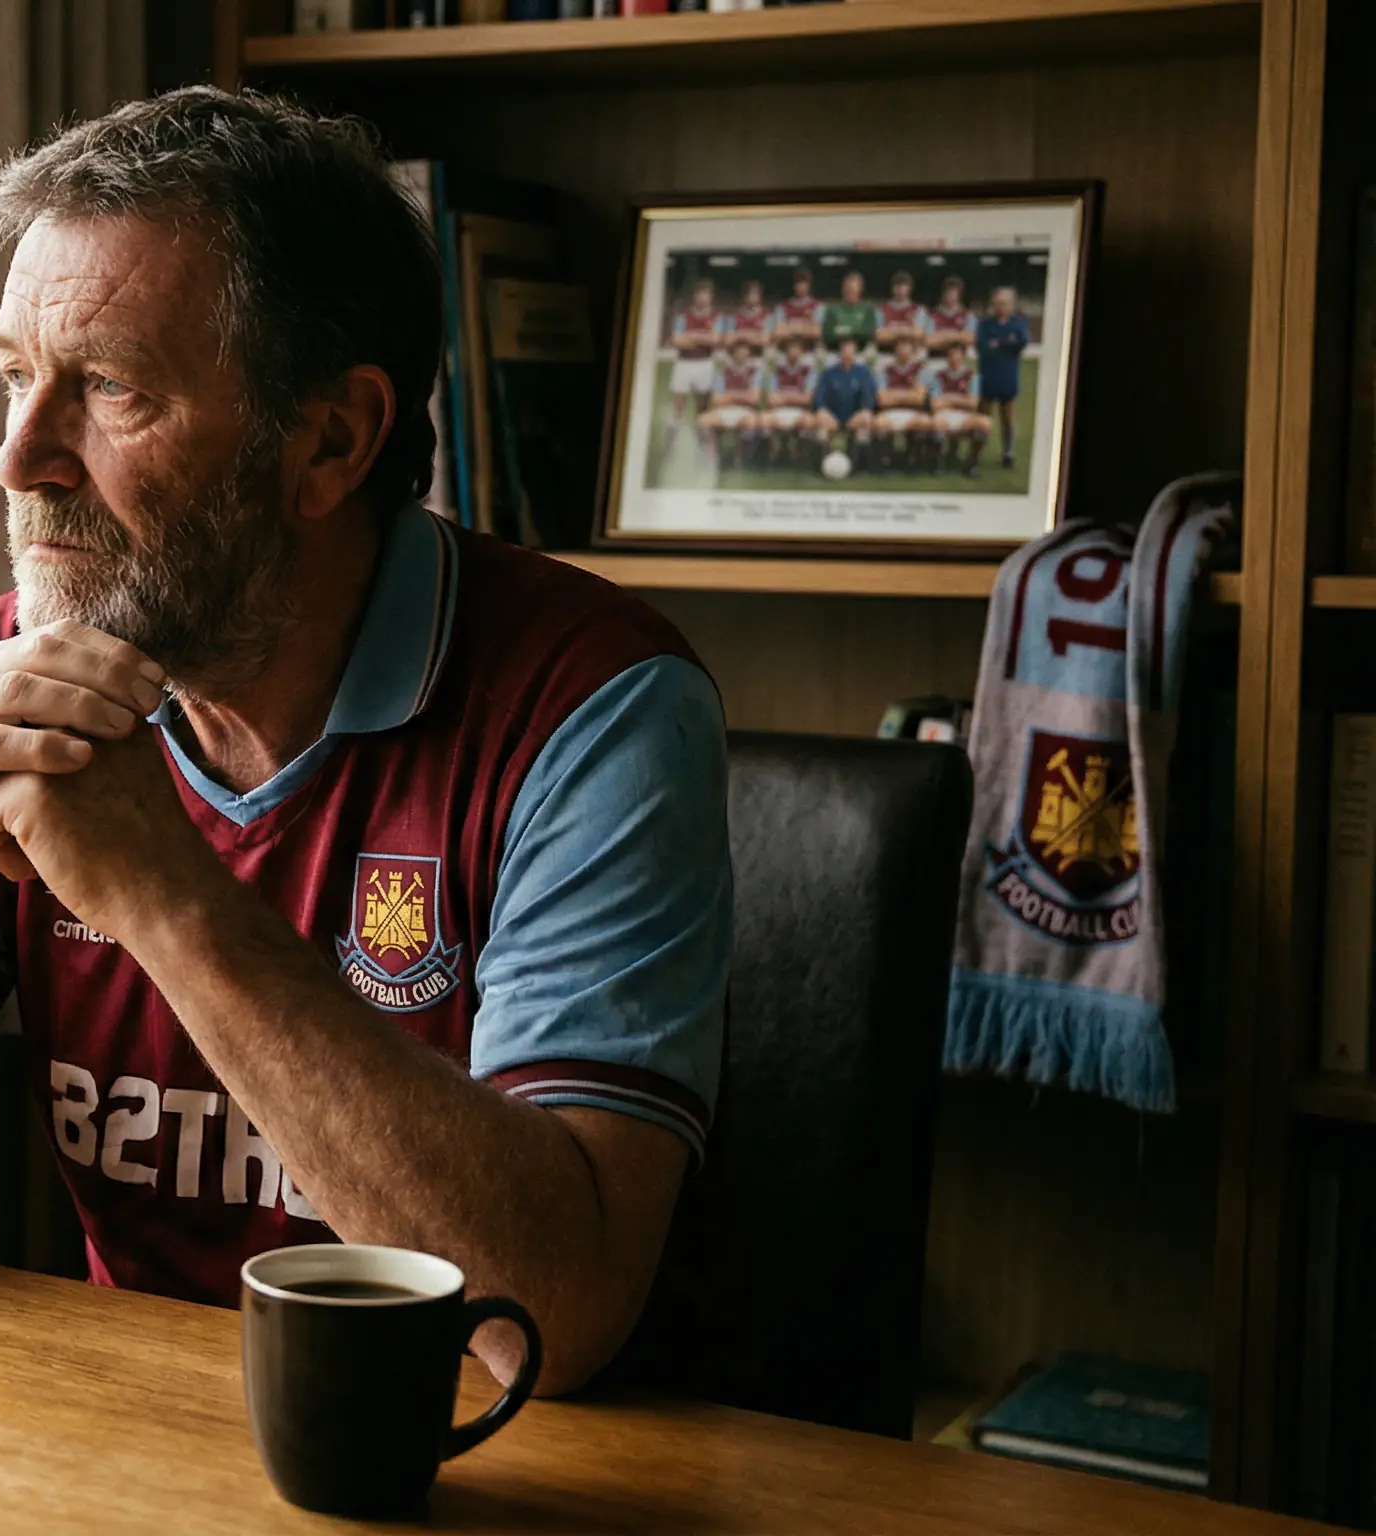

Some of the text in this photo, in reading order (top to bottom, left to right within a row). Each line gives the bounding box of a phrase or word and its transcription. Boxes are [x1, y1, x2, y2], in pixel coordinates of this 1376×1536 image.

[998, 873, 1108, 940] FOOTBALL
[346, 962, 449, 1006] FOOTBALL CLUB
